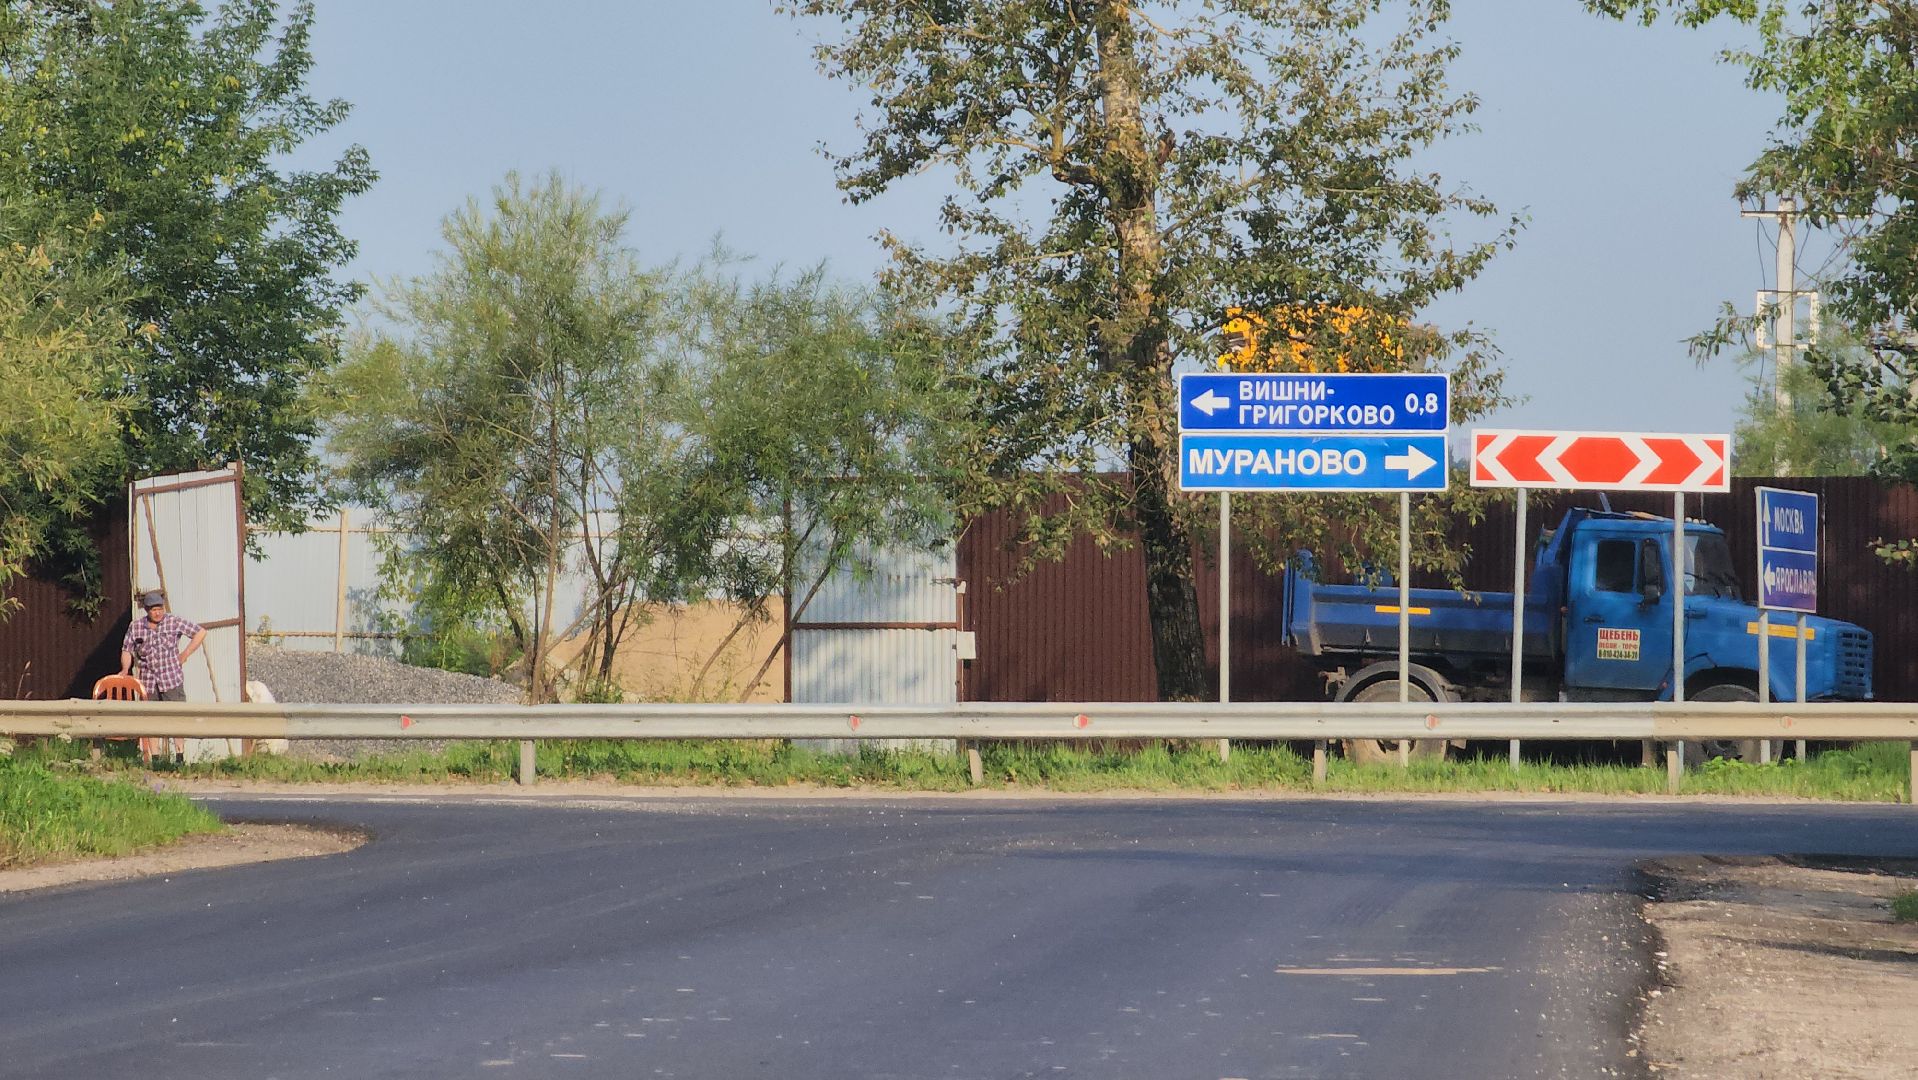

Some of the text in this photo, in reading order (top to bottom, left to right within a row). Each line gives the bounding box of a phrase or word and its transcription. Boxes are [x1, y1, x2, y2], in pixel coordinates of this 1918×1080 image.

[1240, 380, 1335, 401] ВИШНИ-
[1405, 393, 1438, 415] 0,8
[1240, 405, 1395, 425] ГРИГОРКОВО
[1189, 448, 1367, 475] МУРАНОВО
[1774, 507, 1804, 535] МОСКВА
[1599, 629, 1639, 641] ЩЕБЕНЬ
